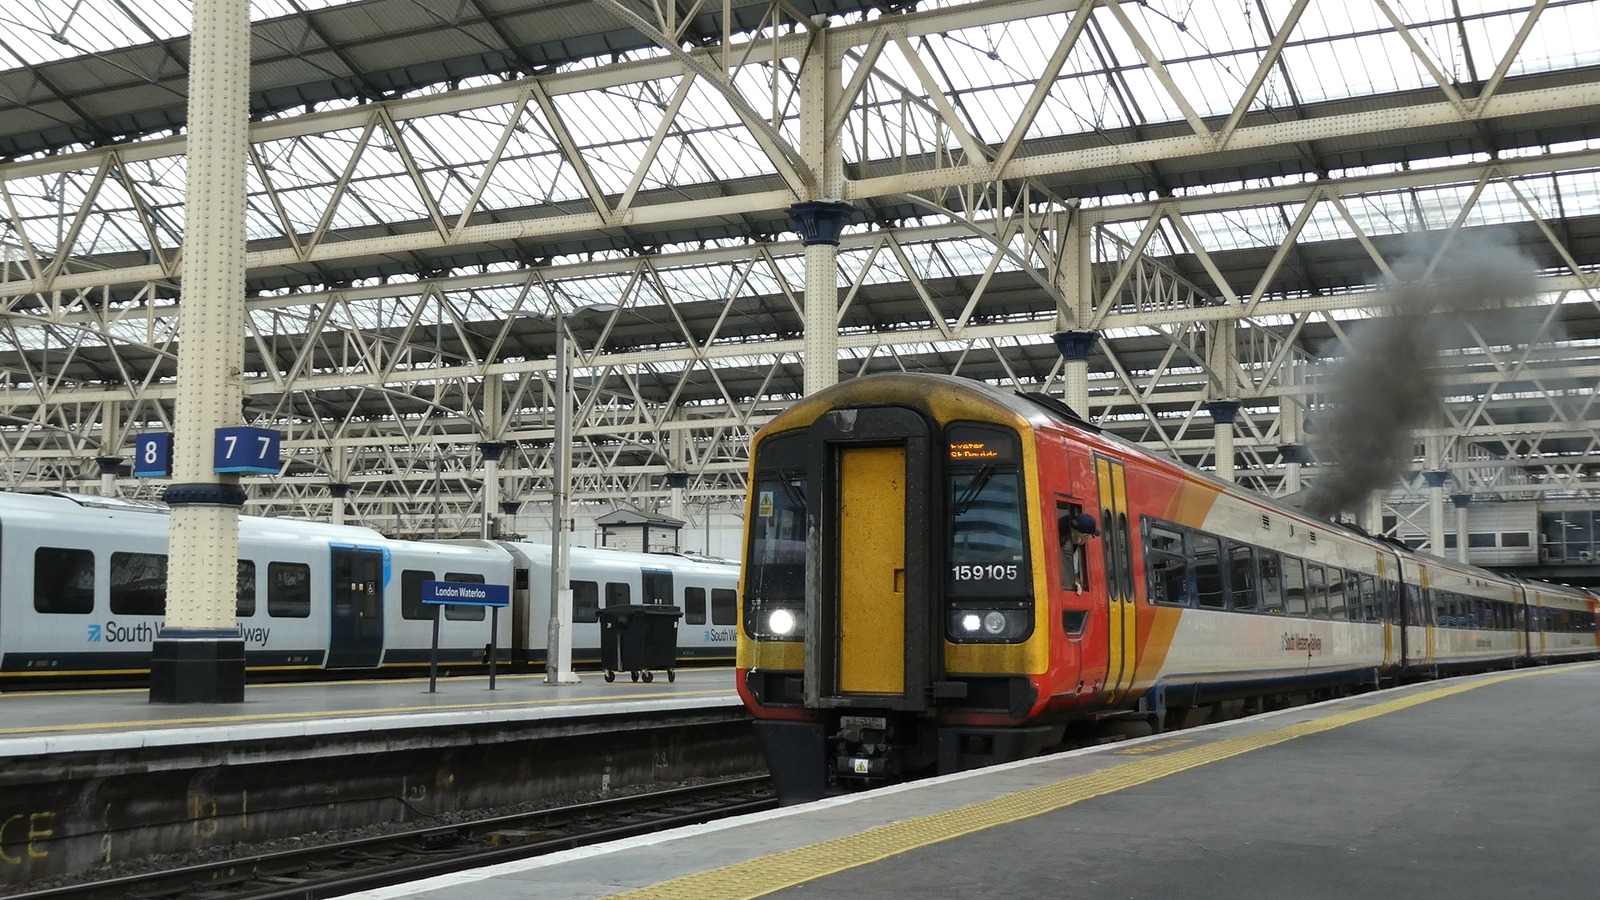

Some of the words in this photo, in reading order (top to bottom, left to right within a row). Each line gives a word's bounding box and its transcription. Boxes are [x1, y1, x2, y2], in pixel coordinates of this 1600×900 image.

[144, 440, 157, 464] 8
[224, 436, 238, 459] 7
[257, 436, 271, 459] 7
[952, 564, 1018, 580] 159105
[435, 586, 459, 597] London
[459, 587, 486, 599] Waterloo
[105, 621, 152, 643] South
[710, 628, 729, 642] South
